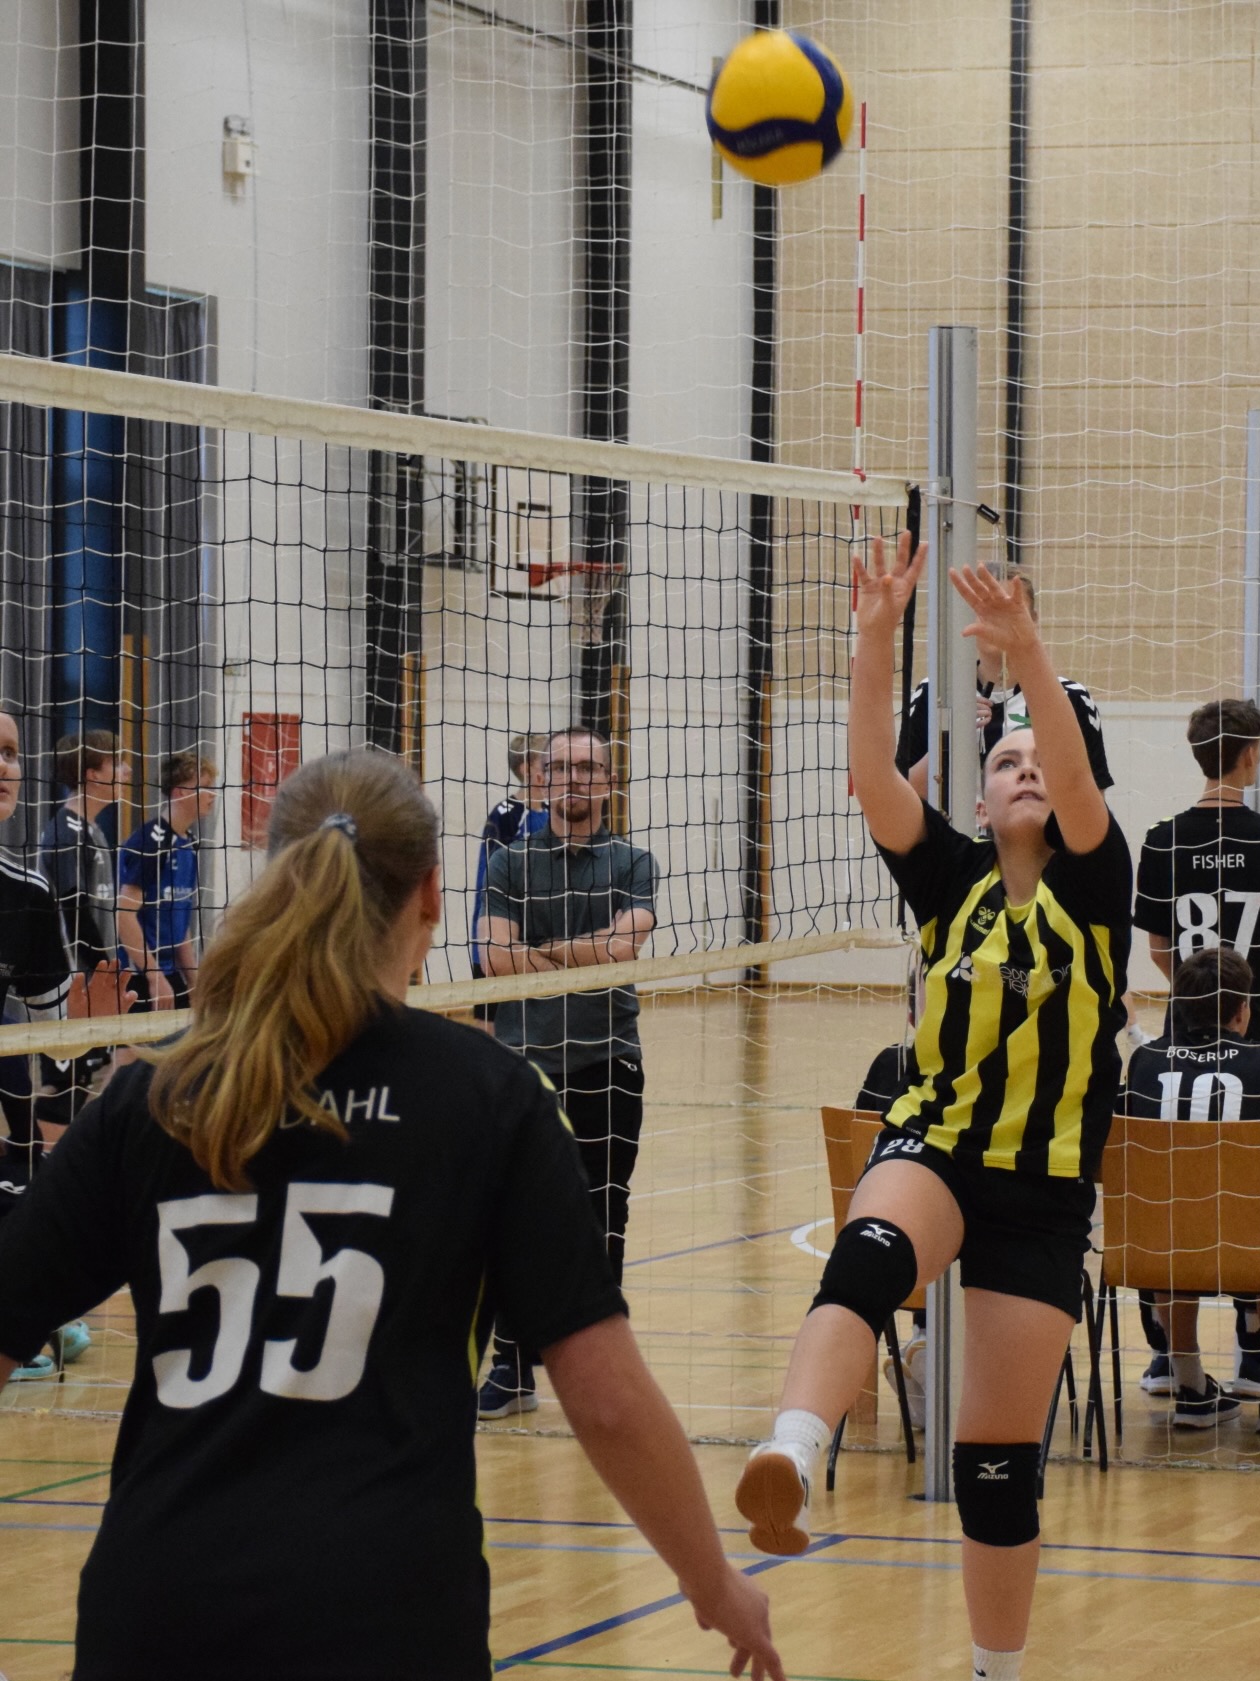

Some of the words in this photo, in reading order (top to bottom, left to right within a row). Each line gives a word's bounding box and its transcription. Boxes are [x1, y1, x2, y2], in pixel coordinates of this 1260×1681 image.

[1192, 853, 1246, 869] FISHER
[1166, 1046, 1239, 1063] BOSERUP
[152, 1182, 395, 1410] 55
